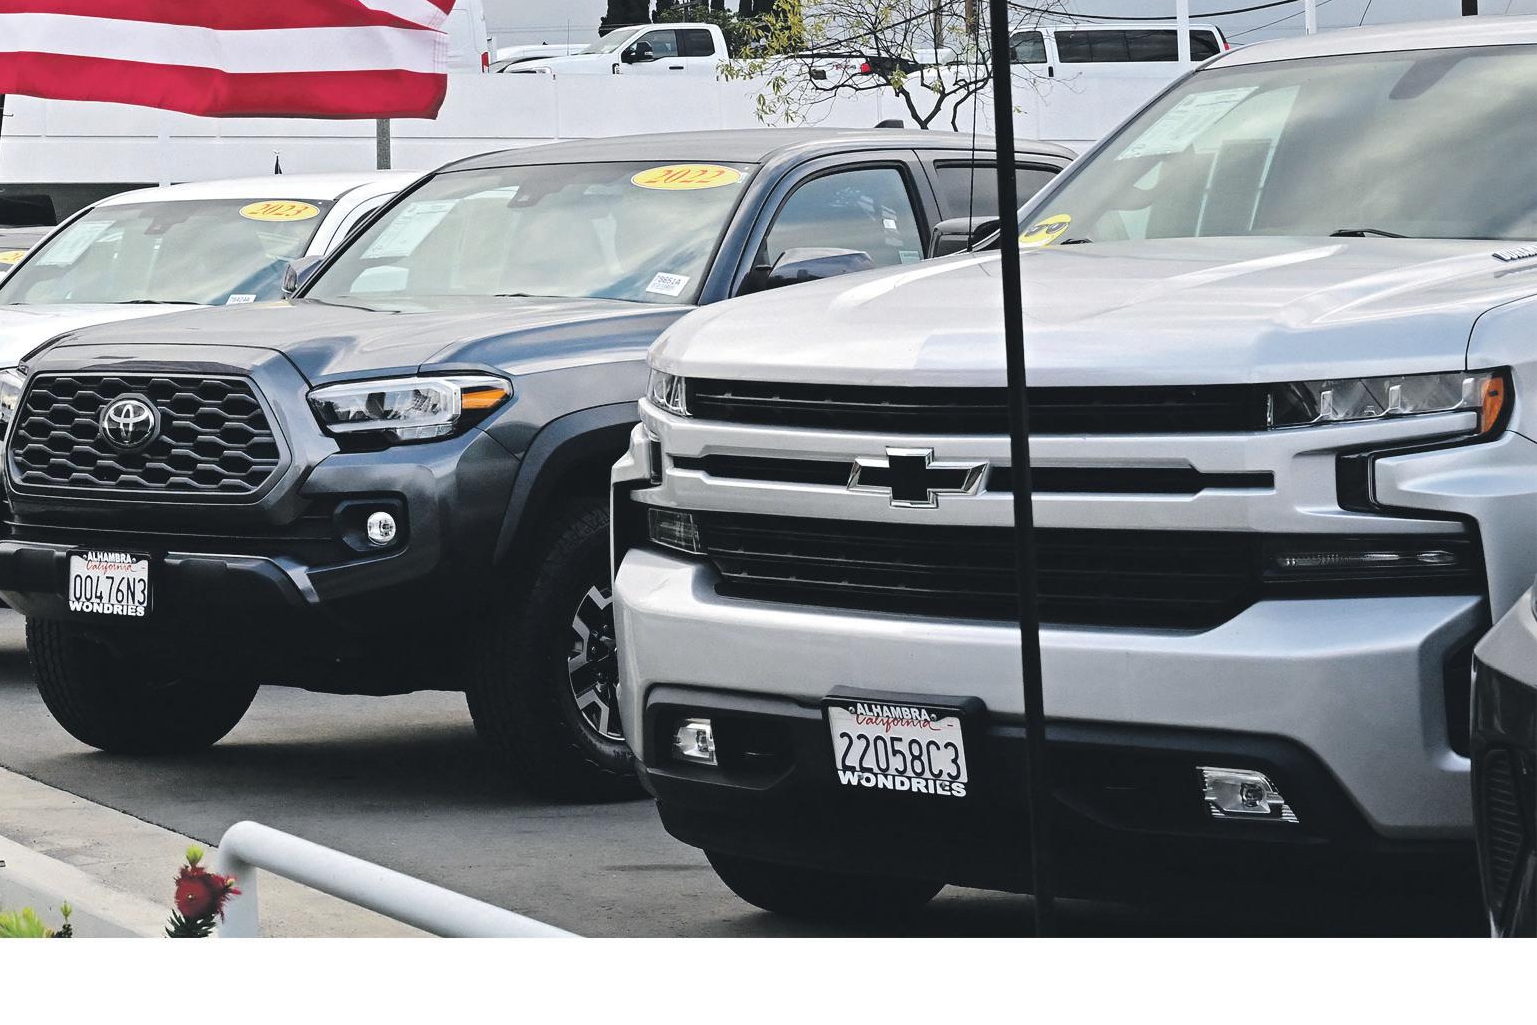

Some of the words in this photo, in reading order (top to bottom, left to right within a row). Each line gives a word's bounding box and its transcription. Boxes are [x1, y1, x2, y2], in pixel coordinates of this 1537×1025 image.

[645, 169, 725, 184] 2022
[249, 203, 309, 217] 2023
[88, 551, 132, 564] ALHAMBRA
[86, 560, 137, 575] California
[74, 574, 147, 606] 00476N3
[69, 601, 145, 616] WONDRIES
[856, 702, 931, 722] ALHAMBRA
[855, 714, 941, 733] California
[839, 731, 961, 781] 22058C3
[838, 770, 966, 797] WONDRIES
